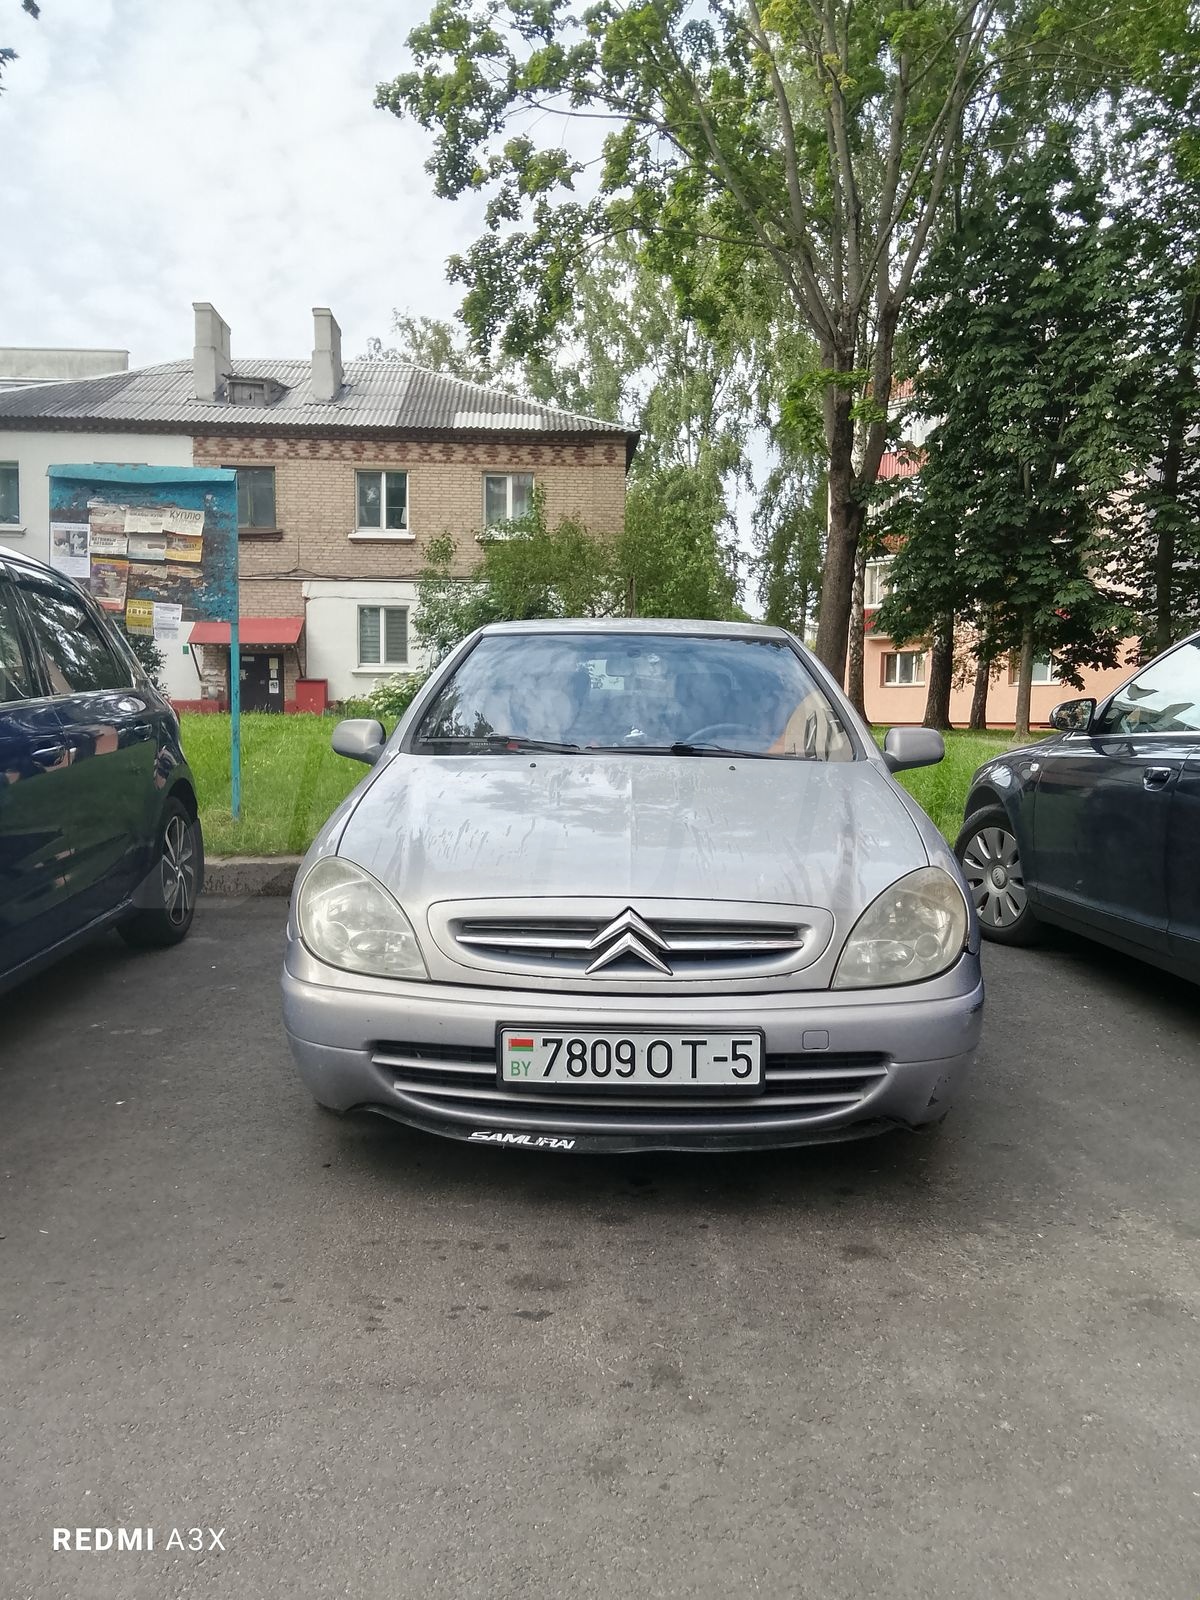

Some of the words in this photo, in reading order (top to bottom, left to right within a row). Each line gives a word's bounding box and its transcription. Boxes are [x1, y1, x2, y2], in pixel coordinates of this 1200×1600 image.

[169, 510, 201, 521] КУПЛЮ
[542, 1038, 636, 1078] 7809
[510, 1060, 532, 1077] BY
[467, 1131, 576, 1149] SAMURAI
